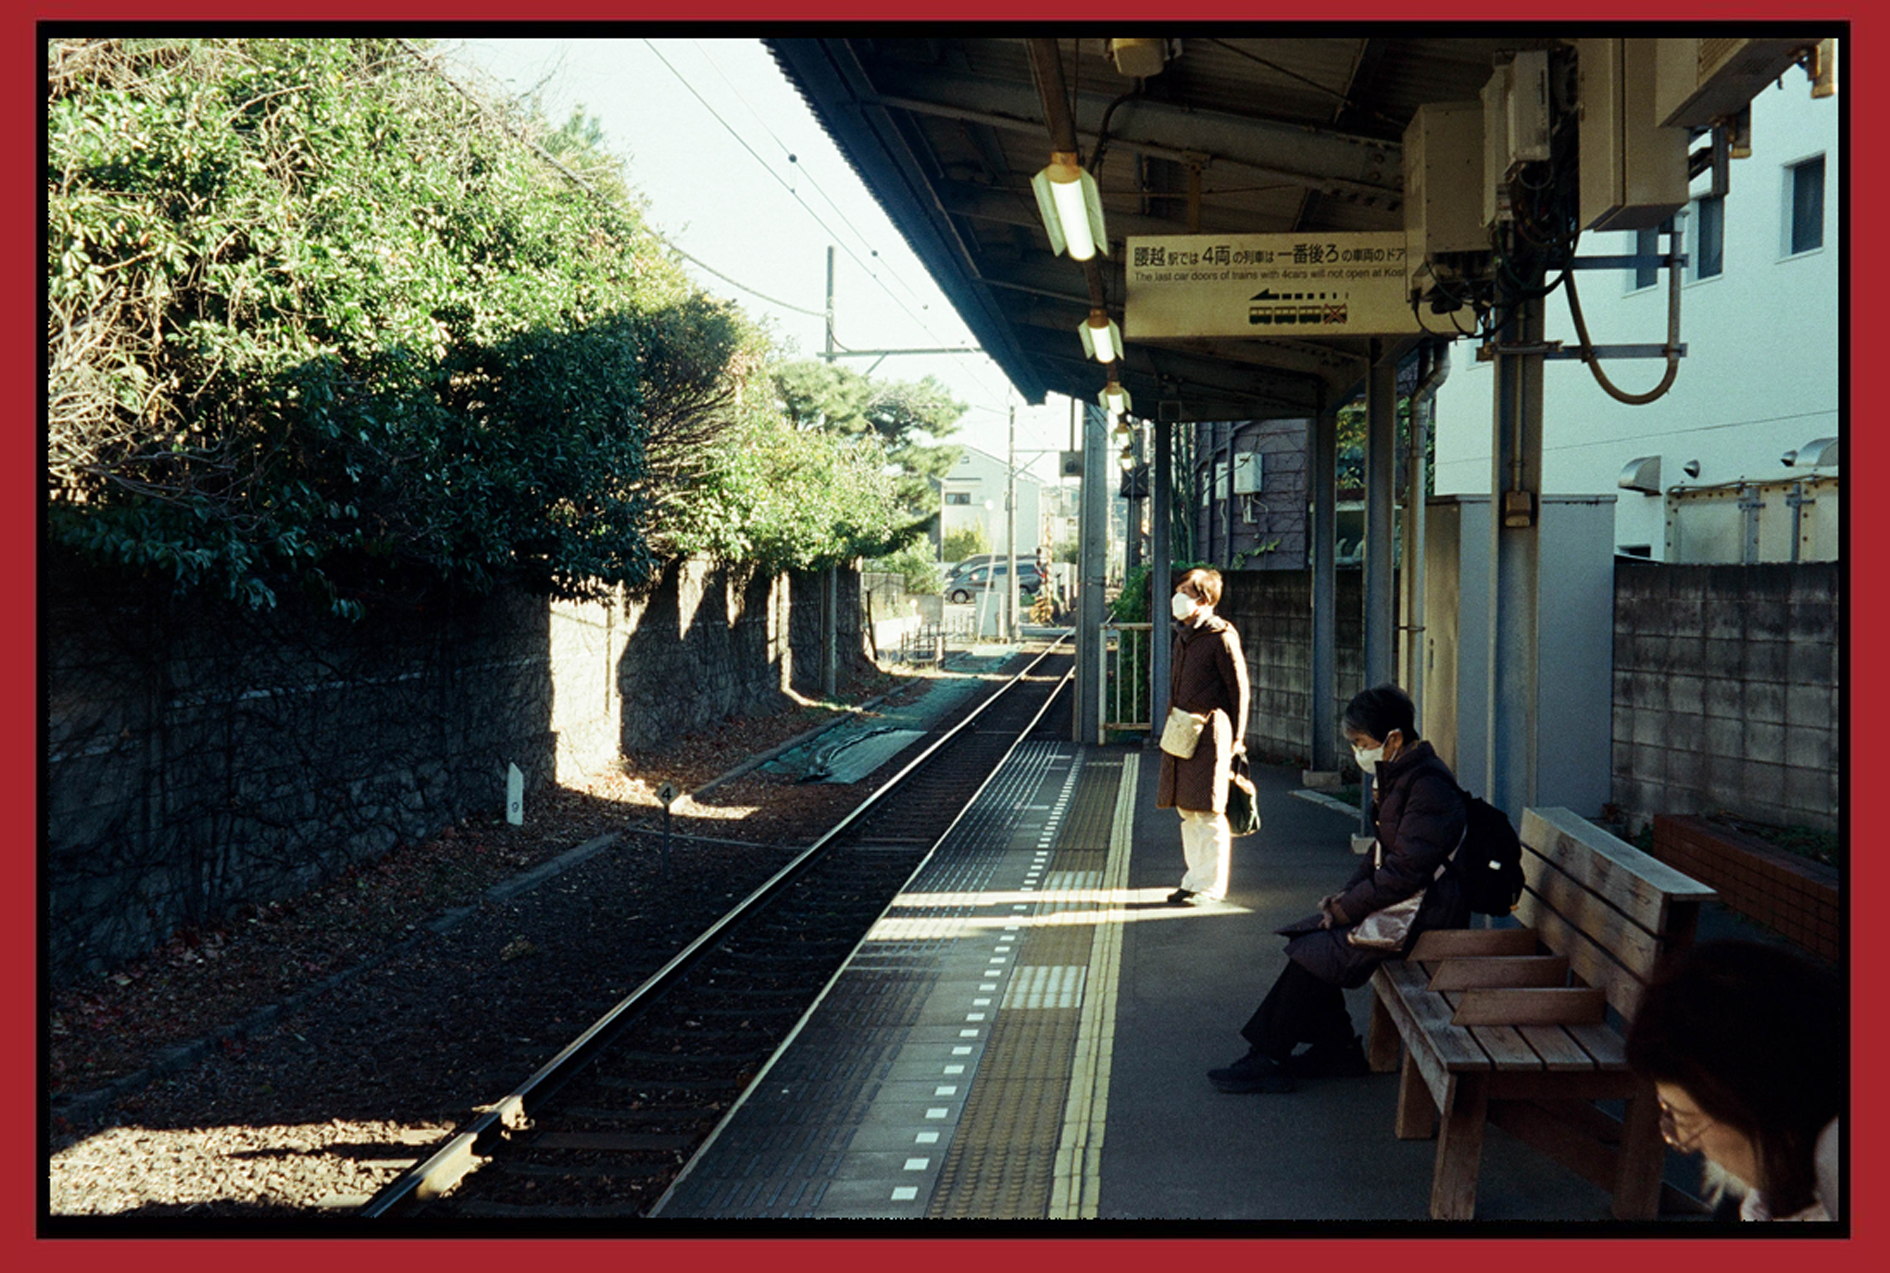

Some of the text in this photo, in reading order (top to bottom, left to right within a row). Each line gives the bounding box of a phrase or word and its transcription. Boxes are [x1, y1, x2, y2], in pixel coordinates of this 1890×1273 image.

[1135, 272, 1152, 281] The
[1155, 272, 1172, 281] last
[1174, 273, 1189, 281] car
[1191, 271, 1218, 280] doors
[1220, 271, 1230, 280] of
[1232, 271, 1258, 280] trains
[1260, 270, 1279, 279] with
[1282, 270, 1307, 279] 4cars
[1310, 269, 1326, 278] will
[1327, 269, 1344, 278] not
[1345, 269, 1370, 279] open
[1372, 269, 1382, 277] at
[661, 786, 673, 801] 4
